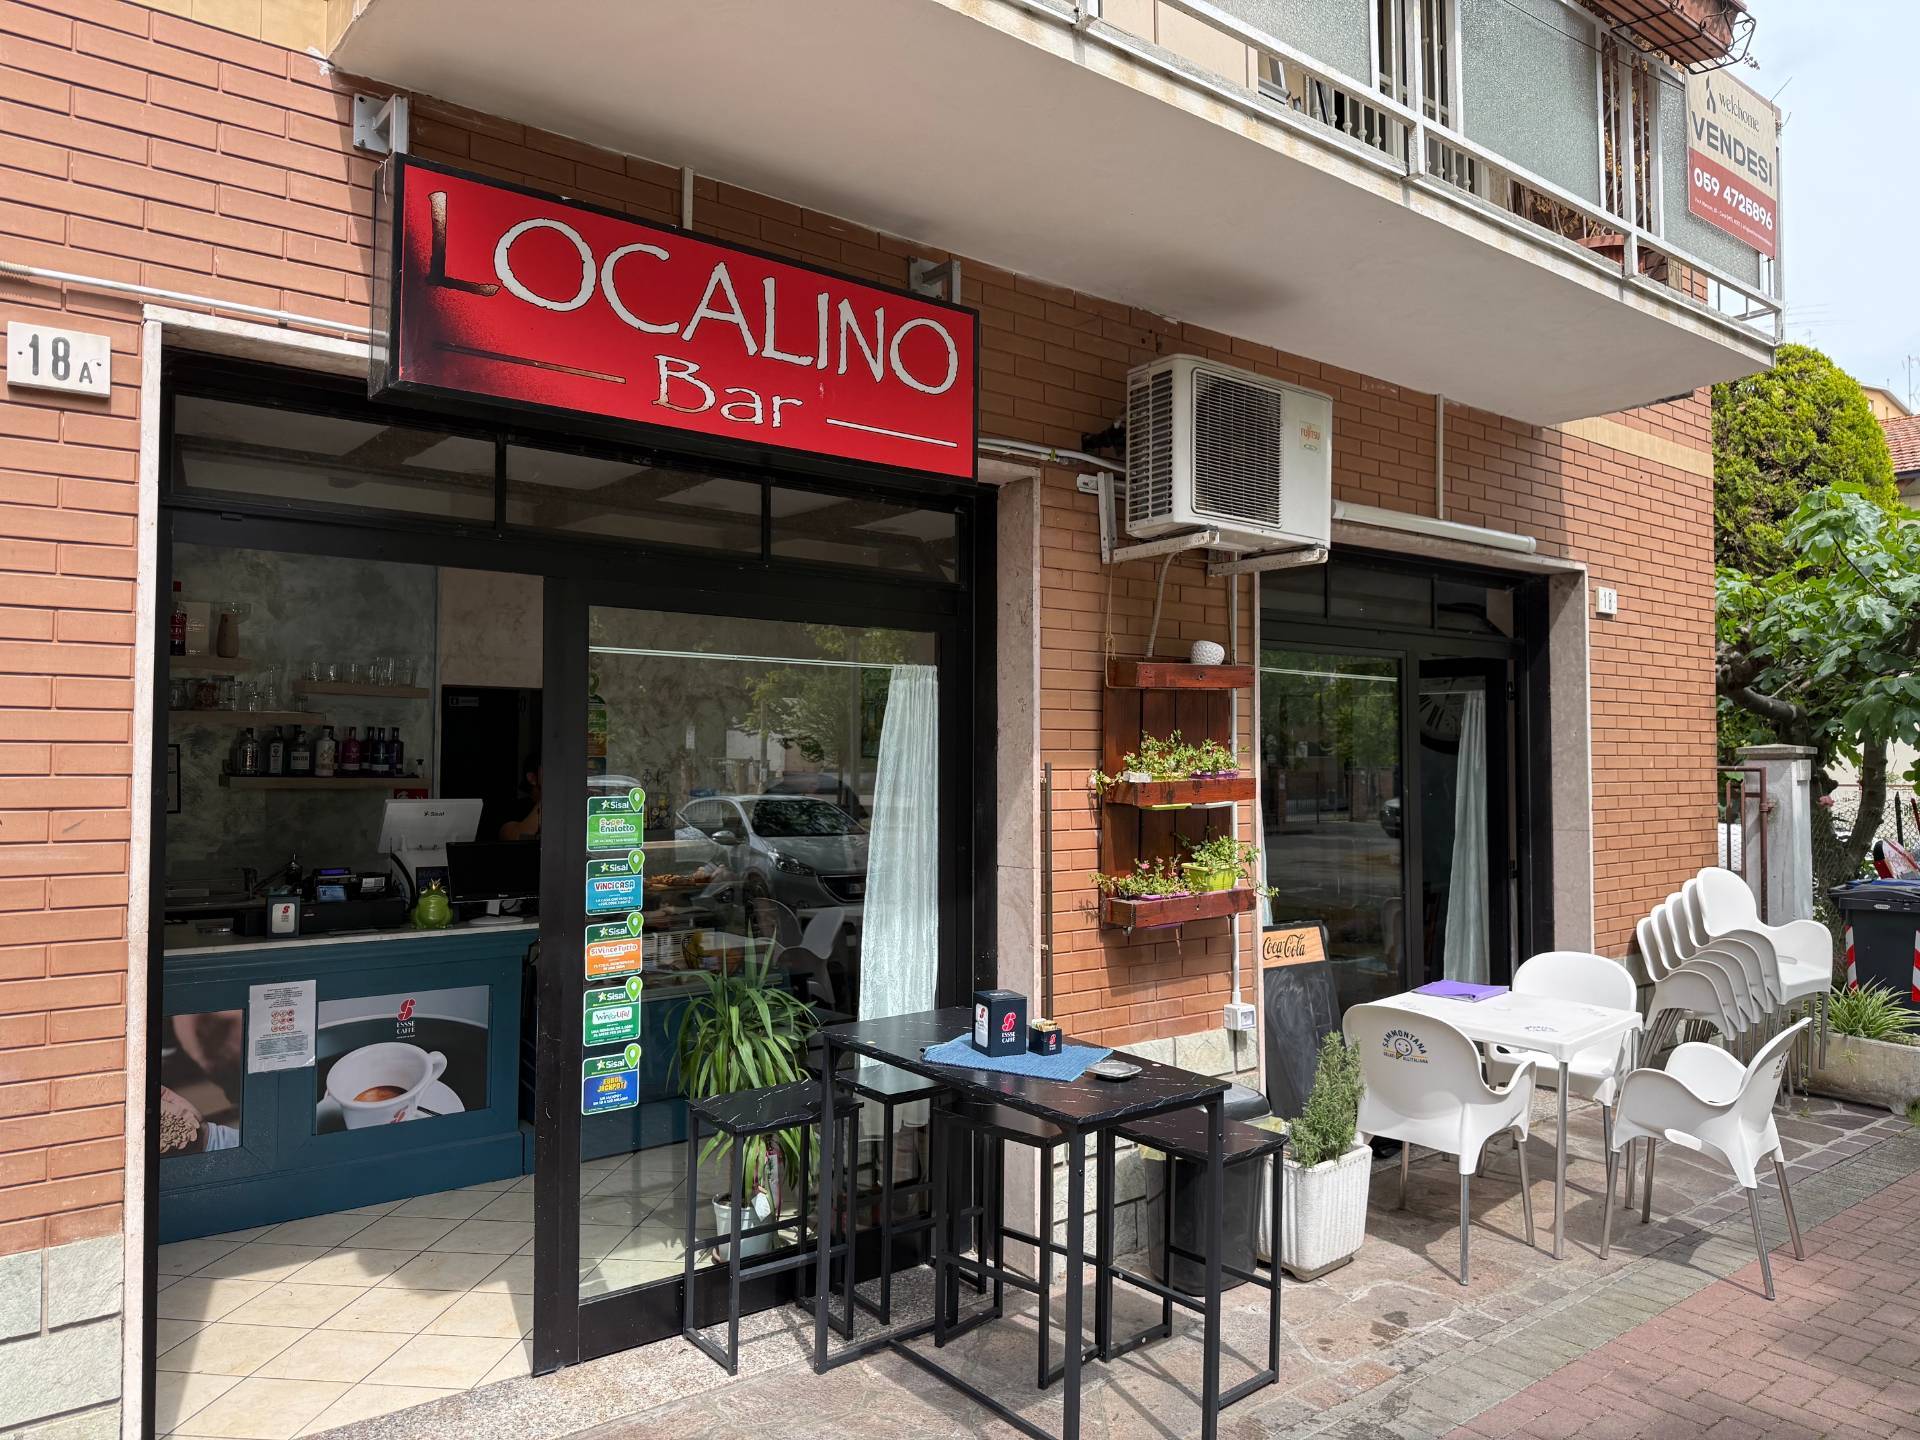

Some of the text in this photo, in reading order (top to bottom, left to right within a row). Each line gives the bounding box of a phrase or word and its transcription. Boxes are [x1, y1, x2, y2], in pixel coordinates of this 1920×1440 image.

[1719, 92, 1759, 133] welchome
[1691, 110, 1773, 187] VENDESI
[1693, 167, 1720, 198] 059
[1722, 184, 1773, 231] 4725896
[428, 190, 959, 394] LOCALINO
[652, 354, 803, 428] Bar
[610, 801, 630, 809] Sisal
[600, 818, 625, 827] Super
[600, 823, 635, 833] Enalotto
[609, 863, 629, 872] Sisal
[608, 927, 628, 936] Sisal
[1262, 933, 1306, 961] Coca-Cola
[607, 991, 626, 1001] Sisal
[1382, 1029, 1427, 1055] SAMMONTANA
[605, 1059, 625, 1069] Sisal
